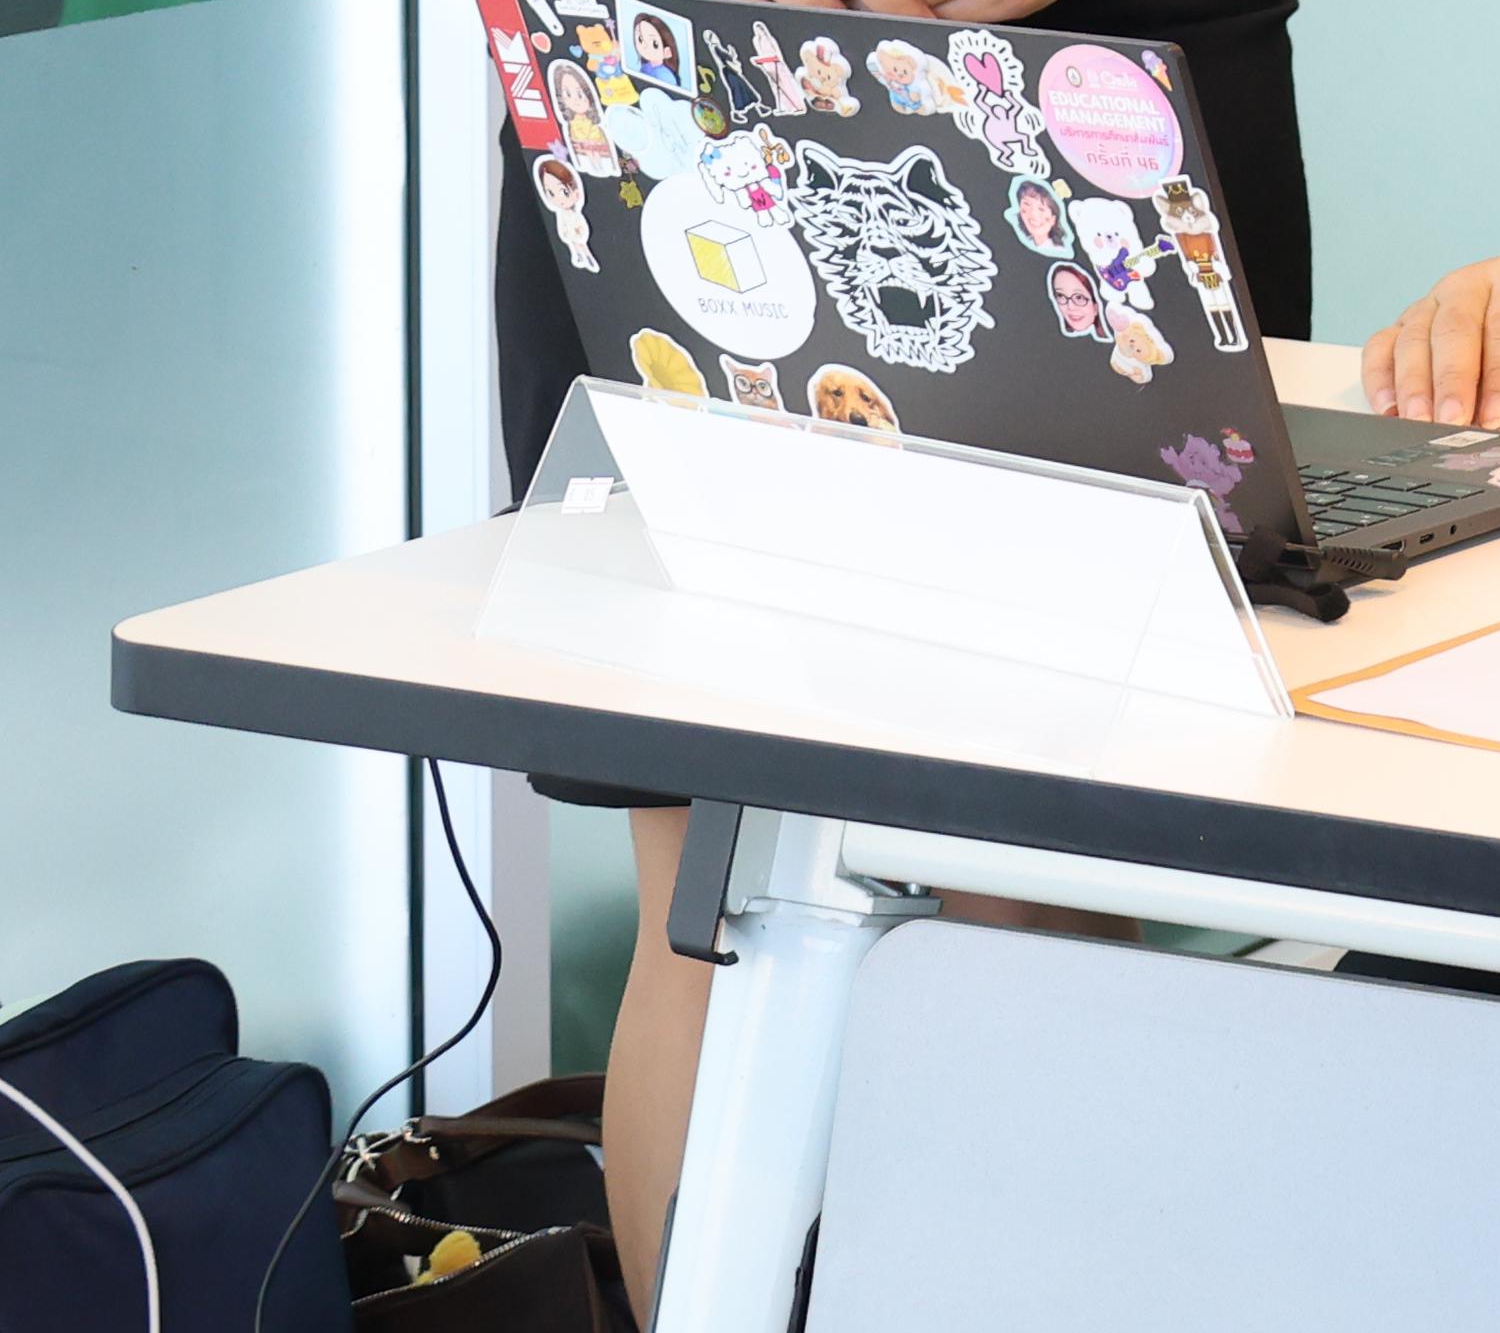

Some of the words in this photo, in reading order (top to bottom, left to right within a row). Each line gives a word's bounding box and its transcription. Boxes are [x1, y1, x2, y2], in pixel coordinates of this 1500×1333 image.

[1048, 90, 1162, 116] EDUCATIONAL
[1053, 108, 1166, 131] MANAGEMENT
[1138, 157, 1160, 170] 46
[698, 298, 738, 315] BOXX
[742, 301, 789, 319] MUSIC
